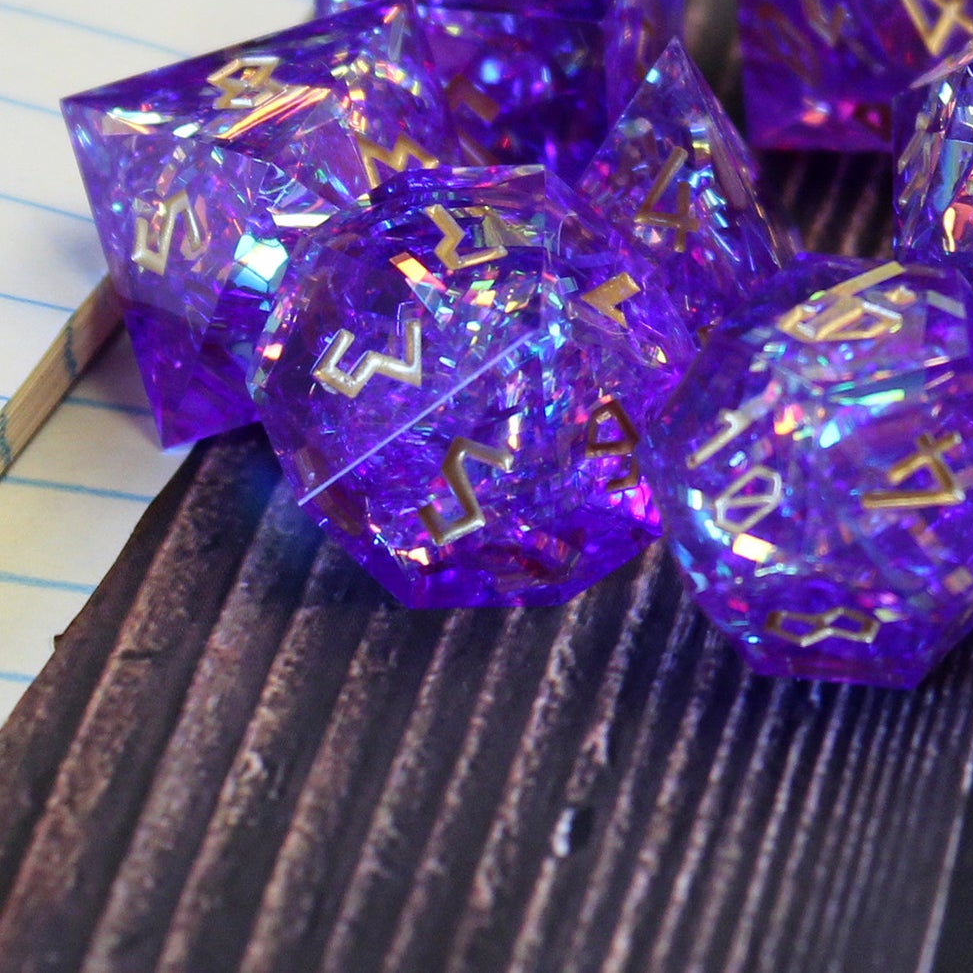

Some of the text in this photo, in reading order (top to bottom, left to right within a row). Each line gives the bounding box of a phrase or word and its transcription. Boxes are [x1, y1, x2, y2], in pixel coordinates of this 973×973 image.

[206, 55, 287, 110] 8
[633, 145, 700, 254] 4
[312, 319, 422, 399] 3
[861, 432, 966, 510] 4
[766, 606, 881, 648] 8
